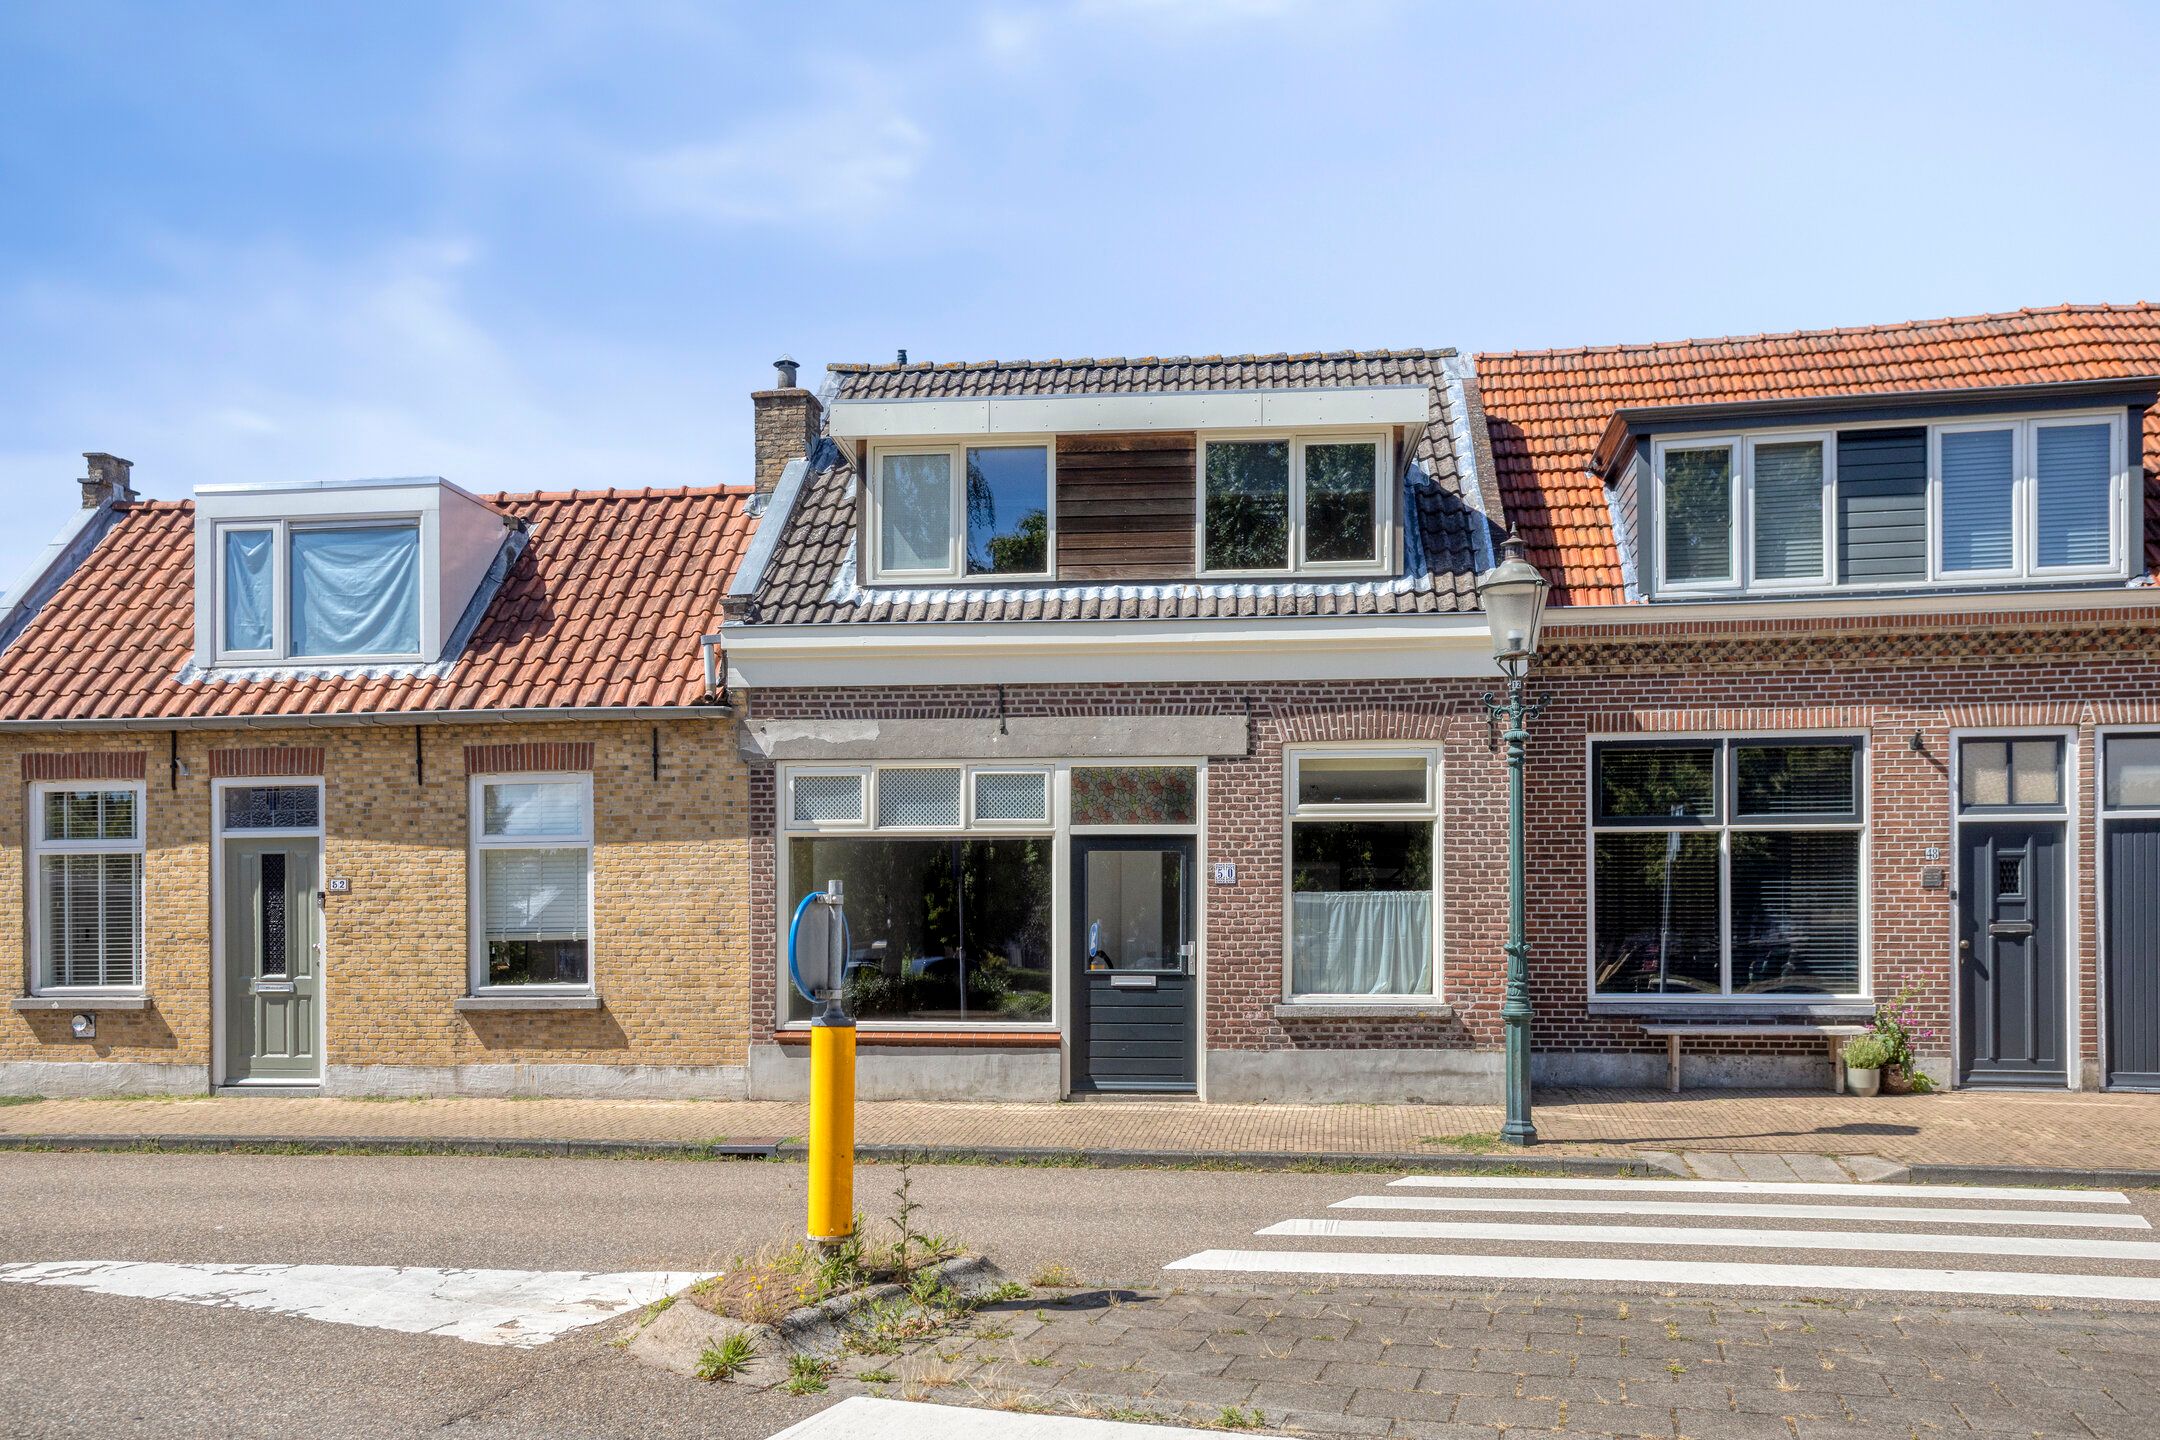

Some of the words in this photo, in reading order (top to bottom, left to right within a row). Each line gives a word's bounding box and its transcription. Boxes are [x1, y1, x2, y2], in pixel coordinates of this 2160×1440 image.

[1926, 848, 1938, 859] 48
[1217, 868, 1233, 878] 50
[332, 880, 345, 889] 52
